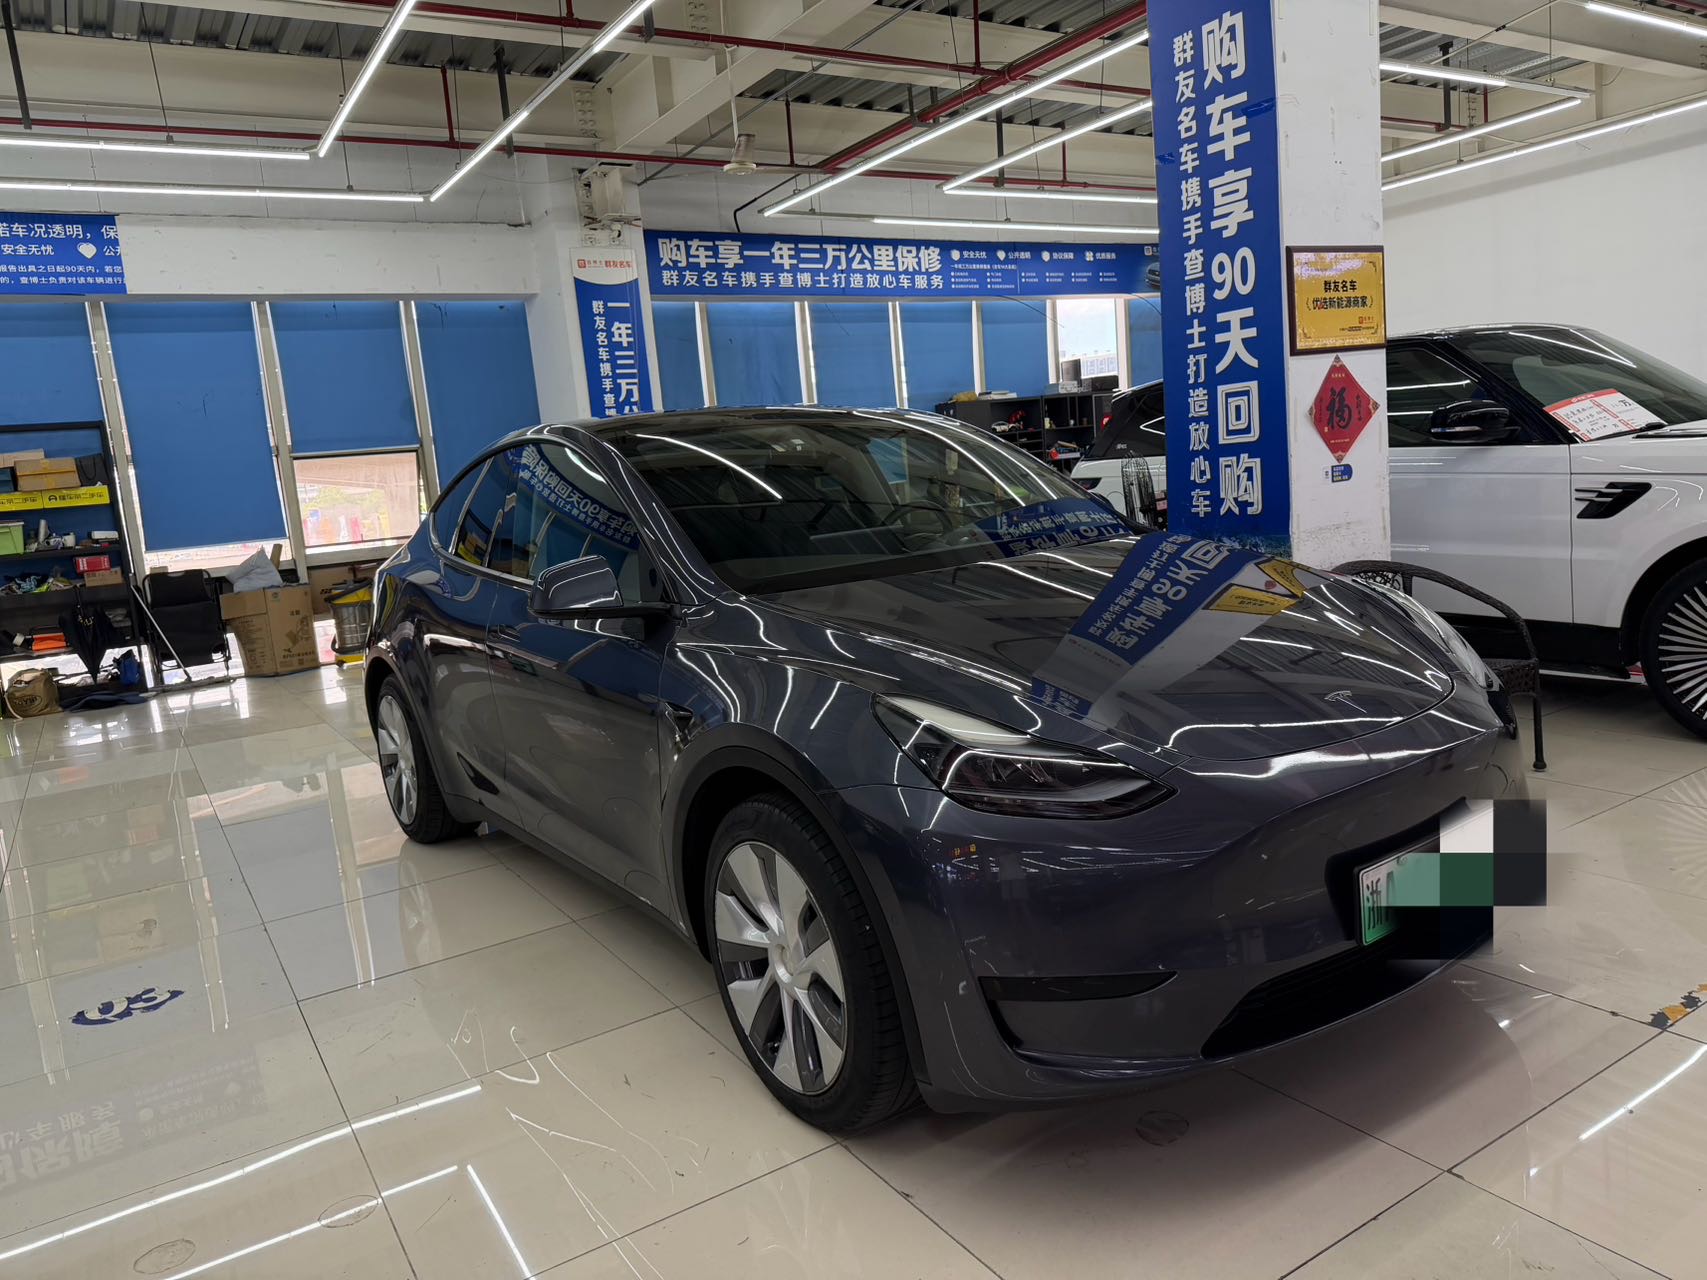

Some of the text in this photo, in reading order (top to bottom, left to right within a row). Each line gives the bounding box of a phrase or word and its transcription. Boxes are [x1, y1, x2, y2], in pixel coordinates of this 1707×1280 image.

[1, 244, 55, 256] 安全无忧
[657, 238, 943, 272] 购车享一年三万公里保修
[1201, 10, 1264, 516] 购车享90天回购
[0, 276, 125, 285] 的，查博士负责对该车辆进行
[661, 270, 944, 289] 群友名车携手查博士打造放心车服务
[1172, 30, 1212, 518] 群友名车携手查博士打造放心车
[1323, 280, 1358, 293] 群友名车
[1326, 387, 1352, 430] 福
